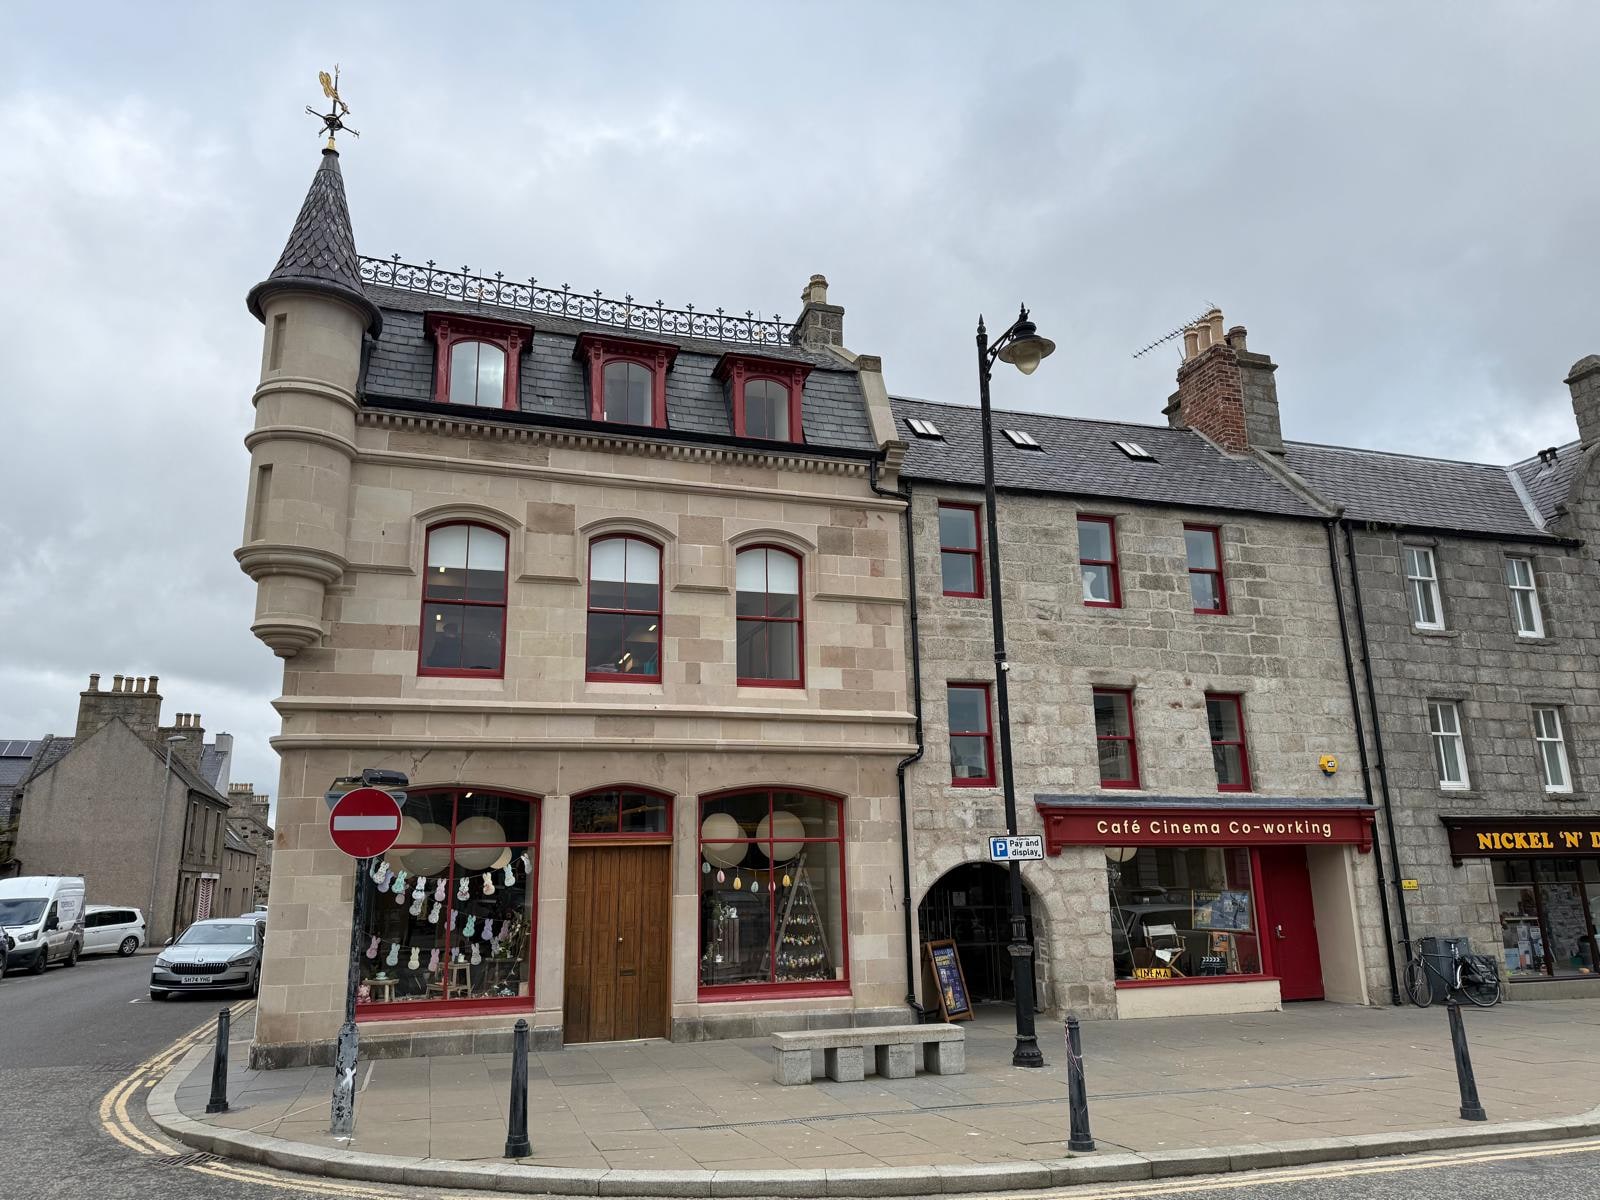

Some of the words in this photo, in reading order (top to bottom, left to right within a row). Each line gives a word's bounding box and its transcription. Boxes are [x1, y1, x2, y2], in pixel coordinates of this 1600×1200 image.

[1097, 819, 1141, 834] Café
[1149, 820, 1220, 834] Cinema
[1229, 820, 1332, 838] Co-working
[1009, 840, 1023, 848] Pay
[1025, 839, 1039, 847] and
[1476, 832, 1554, 850] NICKEL
[1011, 849, 1039, 857] display
[1135, 968, 1169, 979] INEMA
